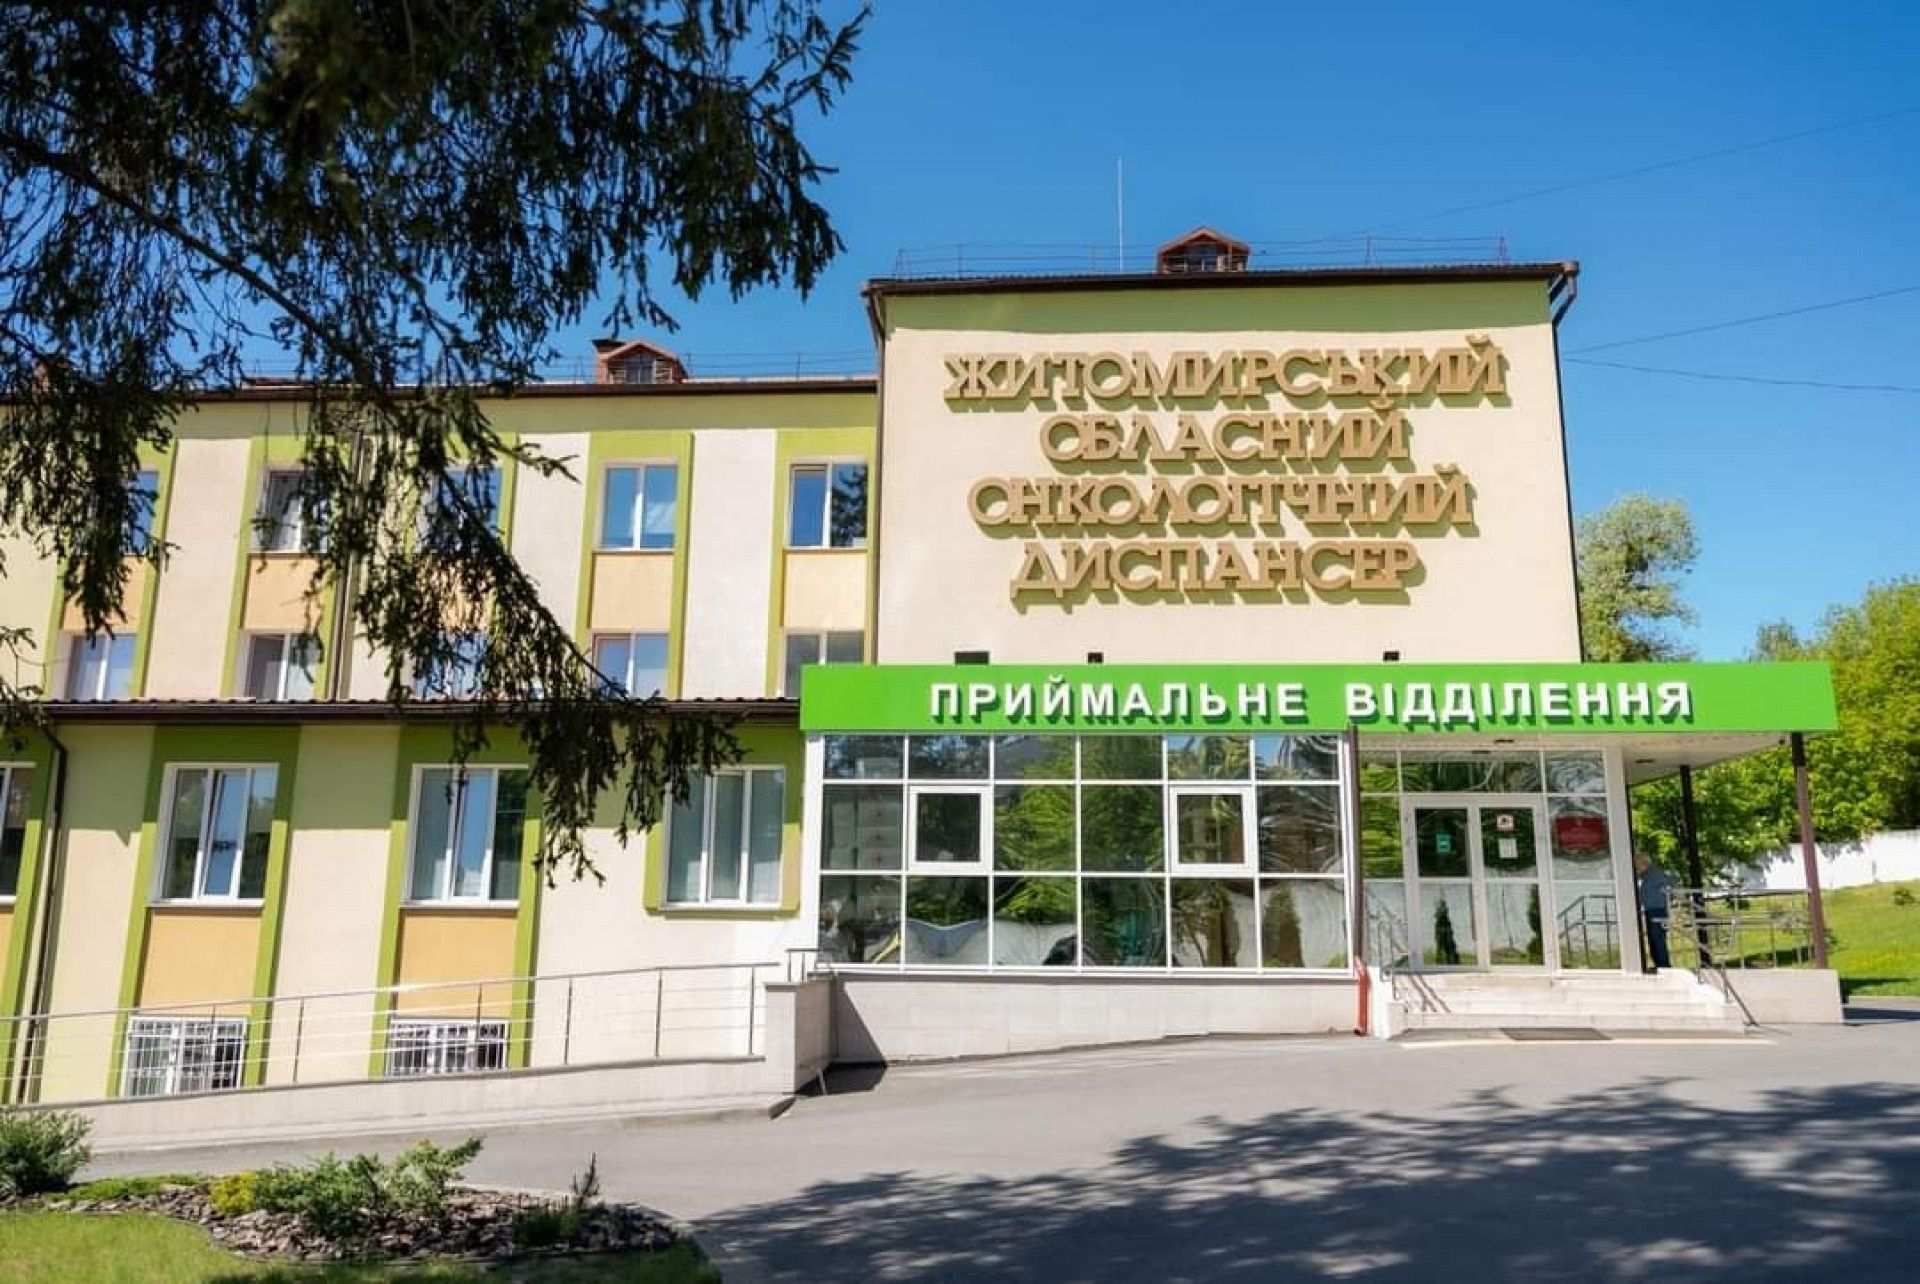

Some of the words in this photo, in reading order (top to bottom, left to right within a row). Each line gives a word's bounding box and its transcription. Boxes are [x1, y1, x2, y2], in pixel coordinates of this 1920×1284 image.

[944, 334, 1505, 398] ЖИТОМИРСЬКИЙ
[1040, 397, 1408, 460] ОБЛАСНИЙ
[967, 463, 1473, 525] ОНКОЛОГІЧНИЙ
[1010, 541, 1419, 599] ДИСПАНСЕР
[930, 675, 1305, 716] ПРИЙМАЛЬНЕ
[1345, 682, 1691, 723] ВІДДІЛЕННЯ
